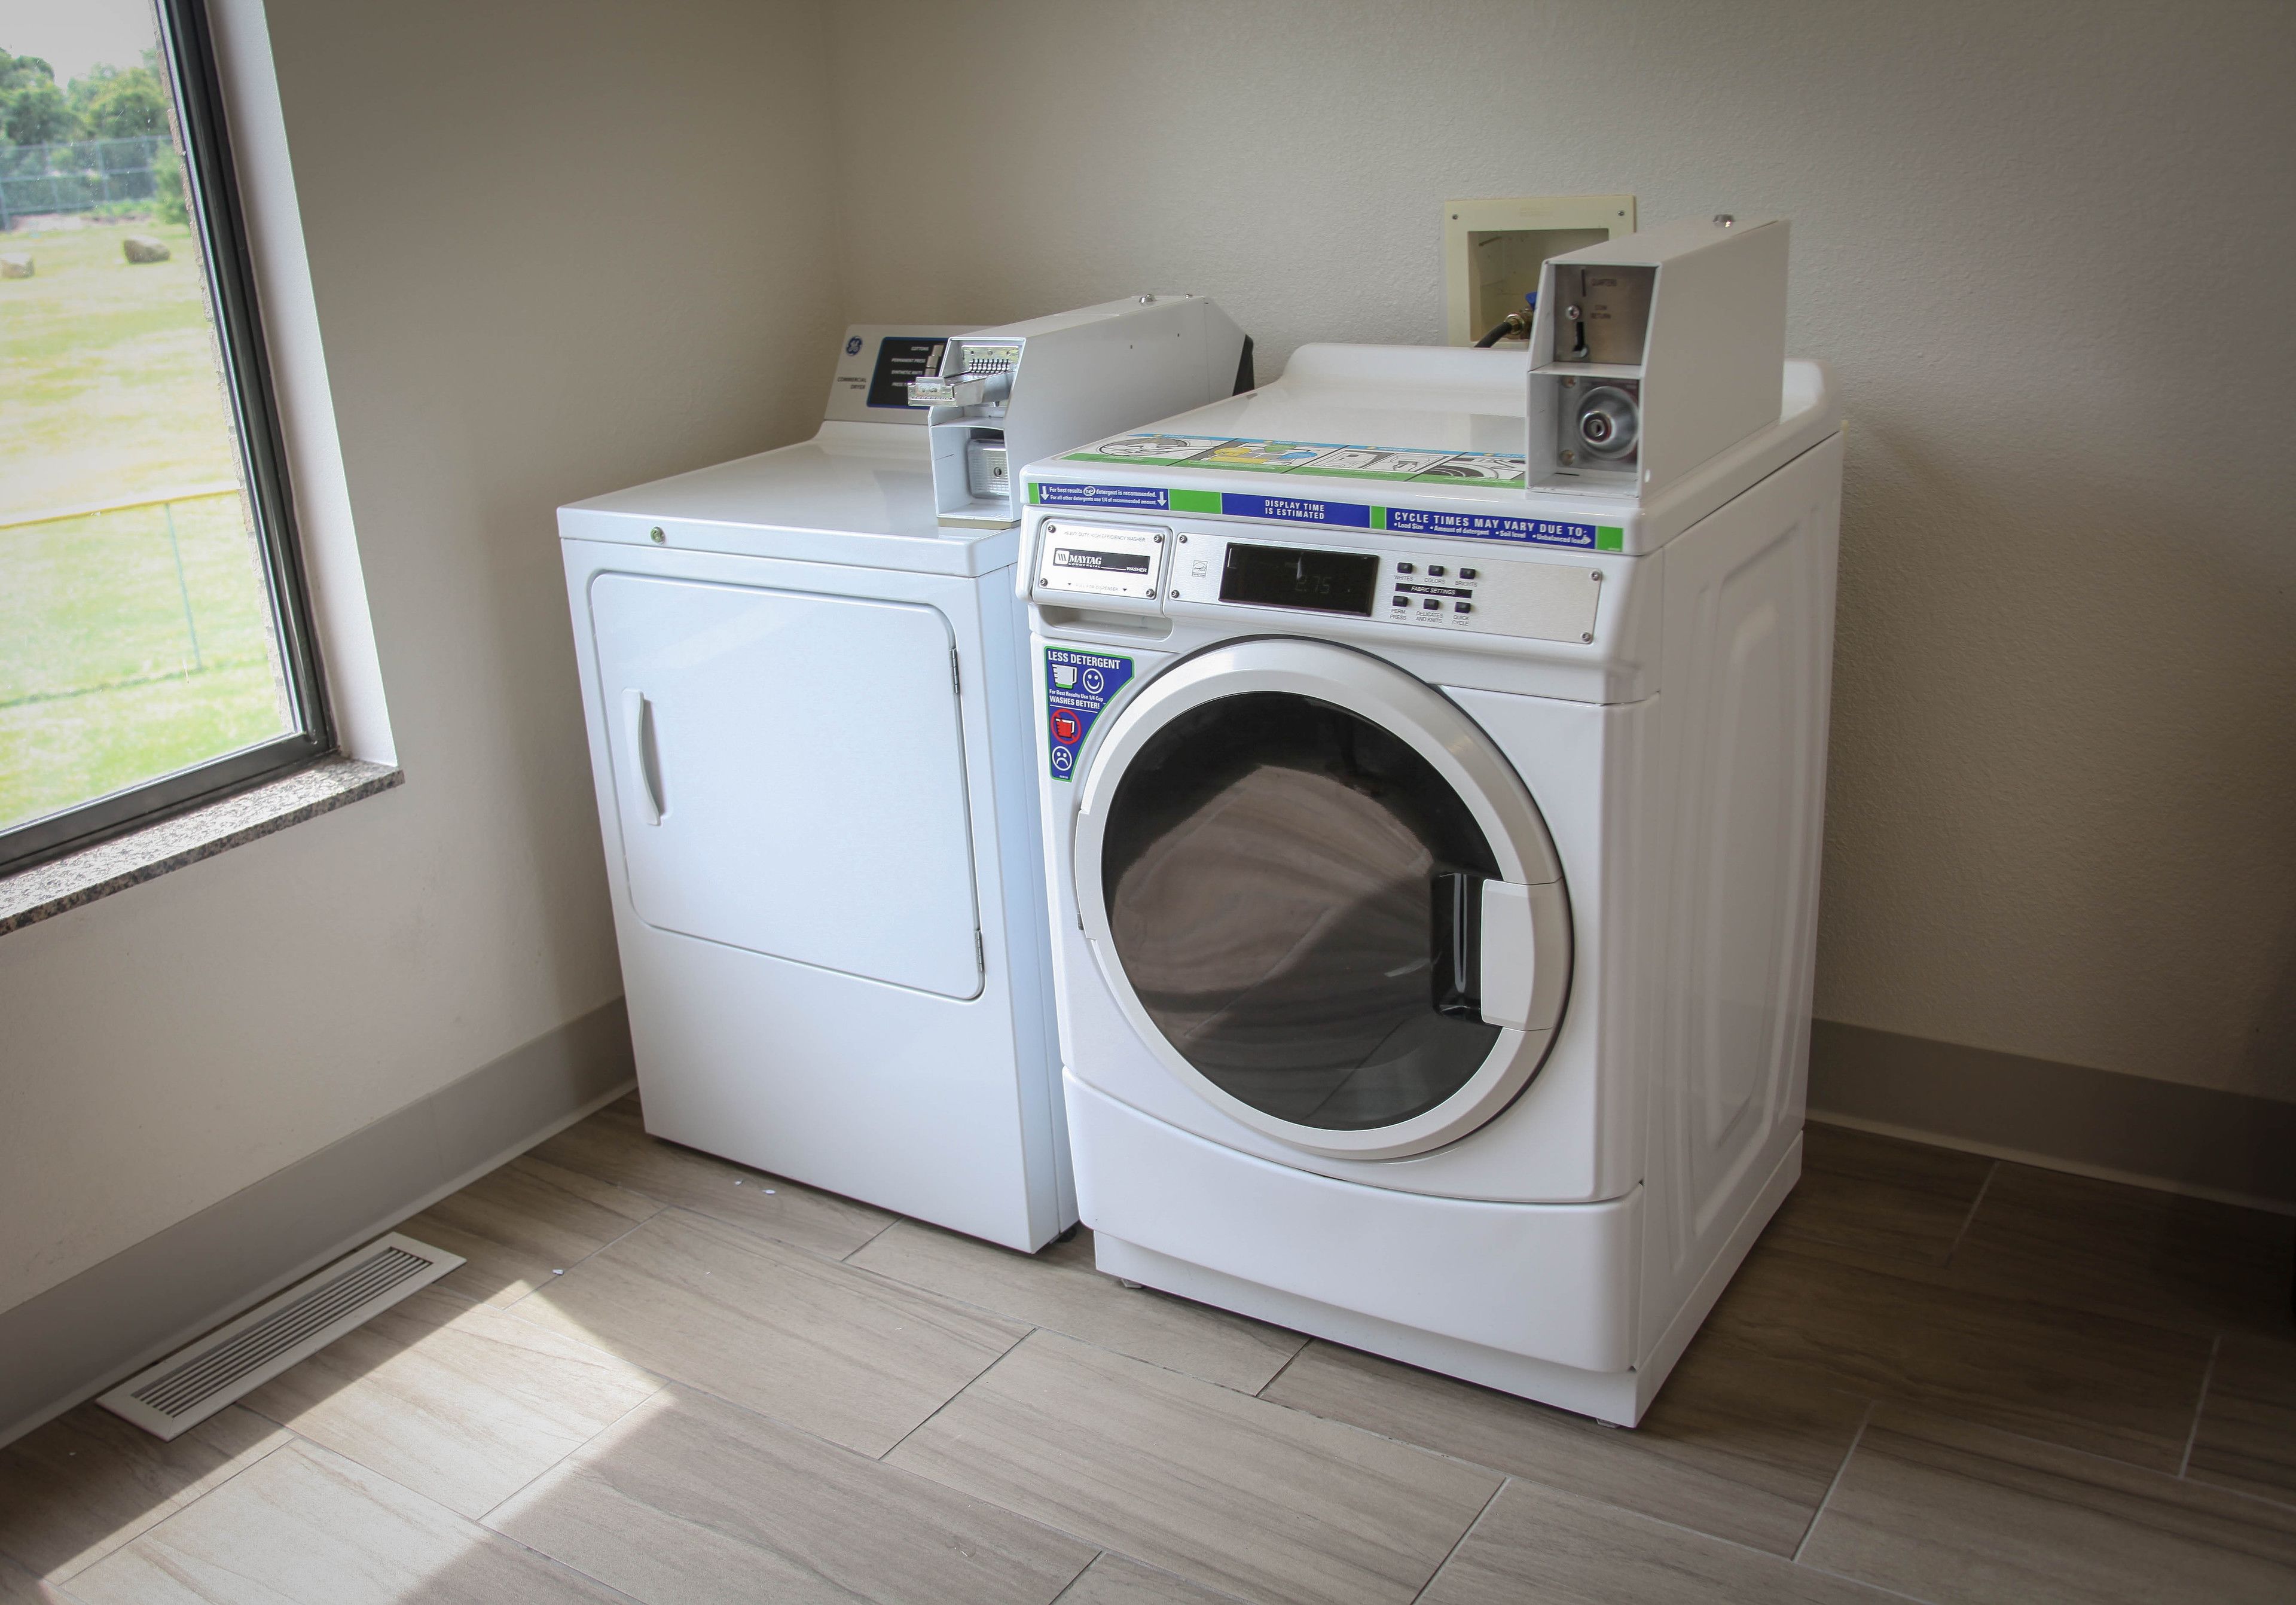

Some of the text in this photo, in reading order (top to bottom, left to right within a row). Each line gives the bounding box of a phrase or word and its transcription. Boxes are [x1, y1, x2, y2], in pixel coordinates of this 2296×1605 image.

[1265, 500, 1324, 511] DISPLAY TIME
[1277, 509, 1324, 519] ESTIMATED
[1394, 512, 1429, 523] CYCLE
[1433, 515, 1469, 526] TIMES
[1474, 518, 1499, 528] MAY
[1504, 520, 1534, 532] VARY
[1539, 524, 1562, 534] DUE
[1068, 554, 1102, 565] MAYTAG
[1048, 651, 1120, 669] LESS DETERGENT
[1049, 695, 1100, 709] WASHES BETTER!
